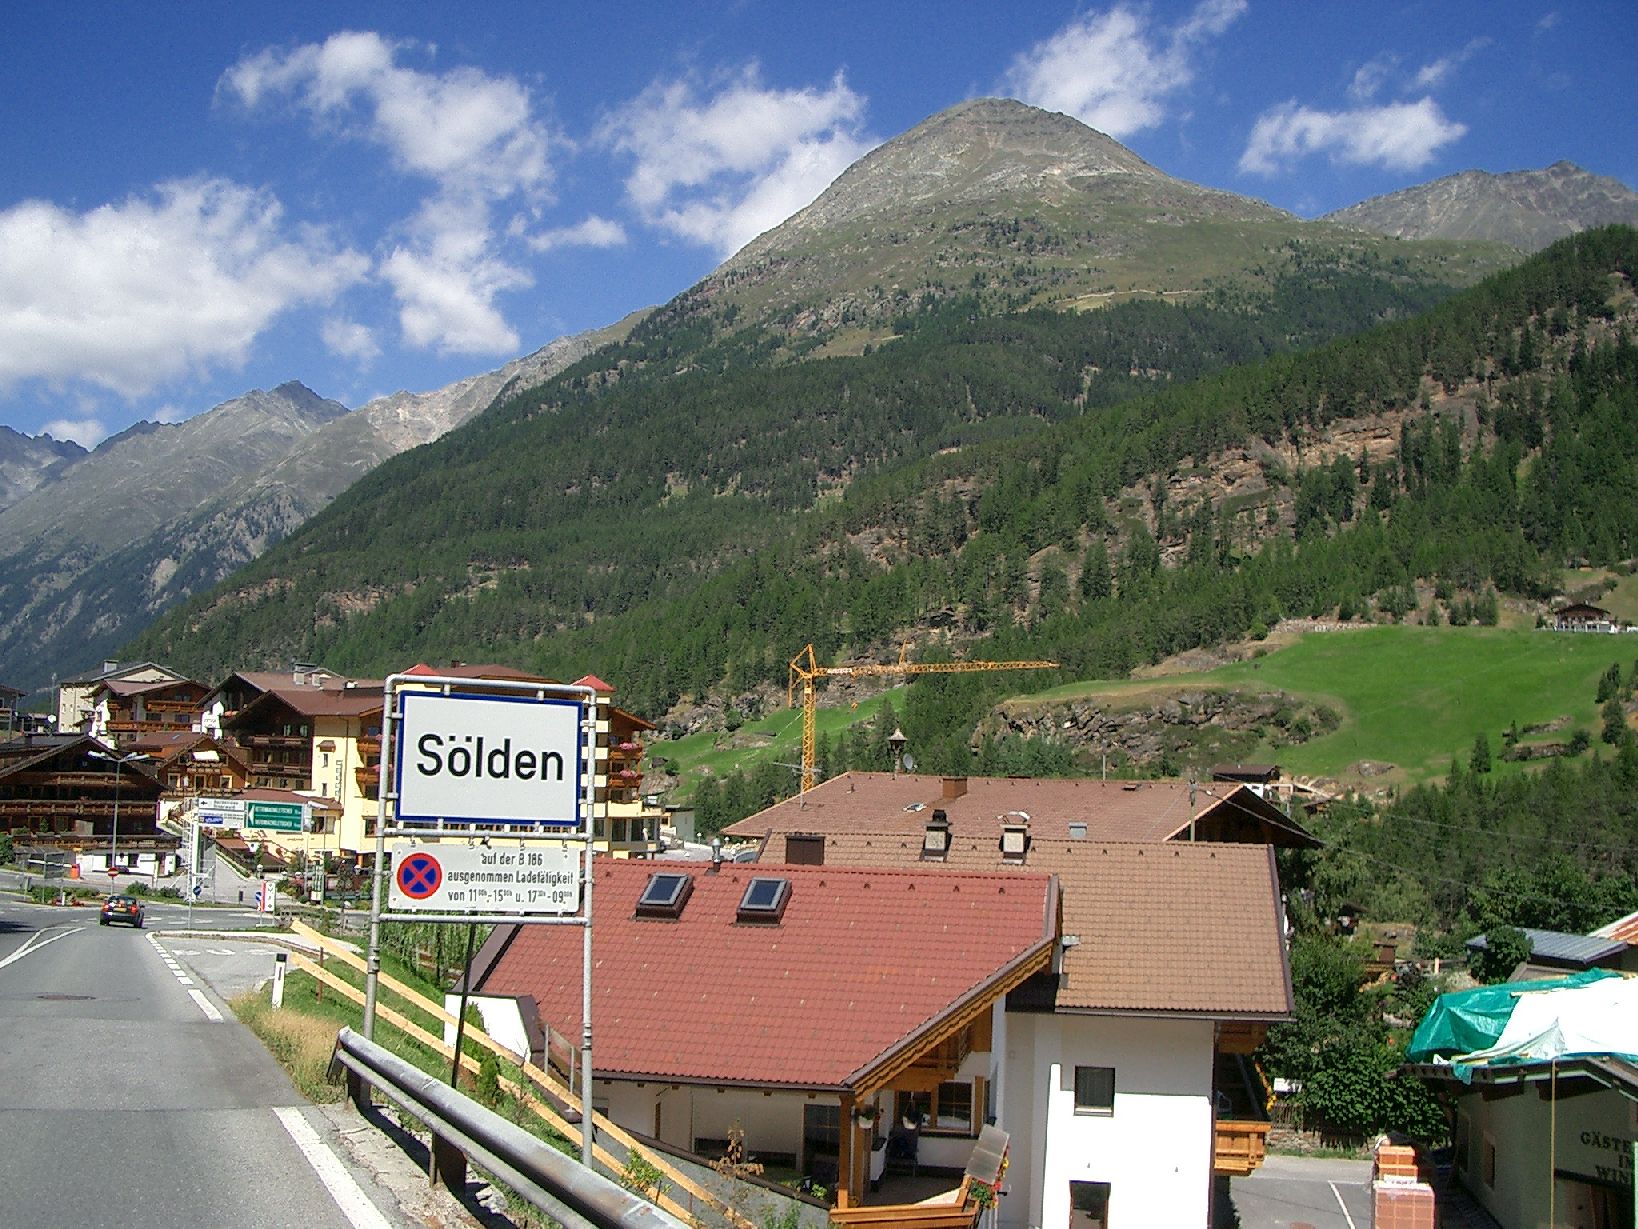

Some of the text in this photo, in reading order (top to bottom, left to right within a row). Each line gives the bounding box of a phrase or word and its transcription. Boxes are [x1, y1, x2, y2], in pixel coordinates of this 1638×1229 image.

[416, 733, 564, 781] Sölden
[481, 852, 543, 866] auf der B 186
[448, 870, 574, 887] ausgenommen Ladetätigkeit
[448, 891, 465, 901] von
[516, 893, 525, 902] u.
